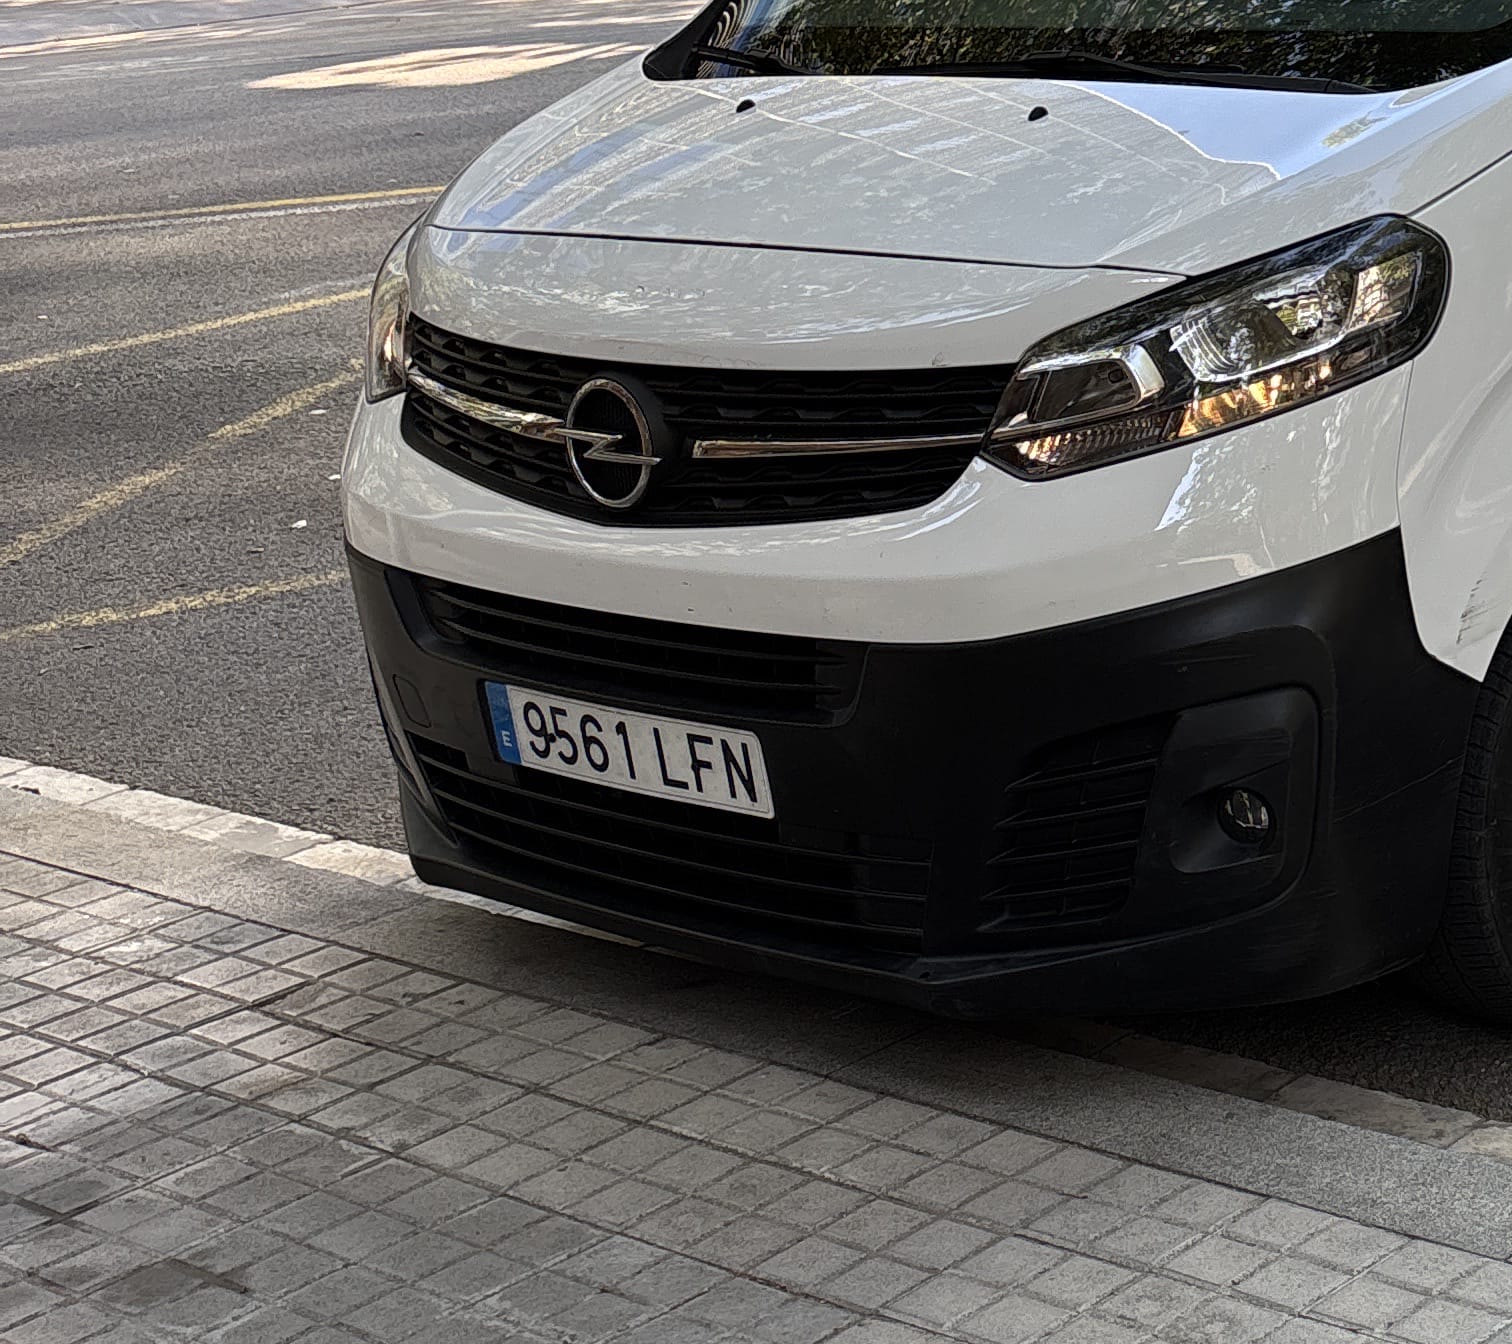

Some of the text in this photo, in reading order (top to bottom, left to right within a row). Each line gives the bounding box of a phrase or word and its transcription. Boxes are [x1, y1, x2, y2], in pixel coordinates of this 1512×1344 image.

[501, 730, 513, 748] E
[523, 701, 758, 803] 9561 LFN
